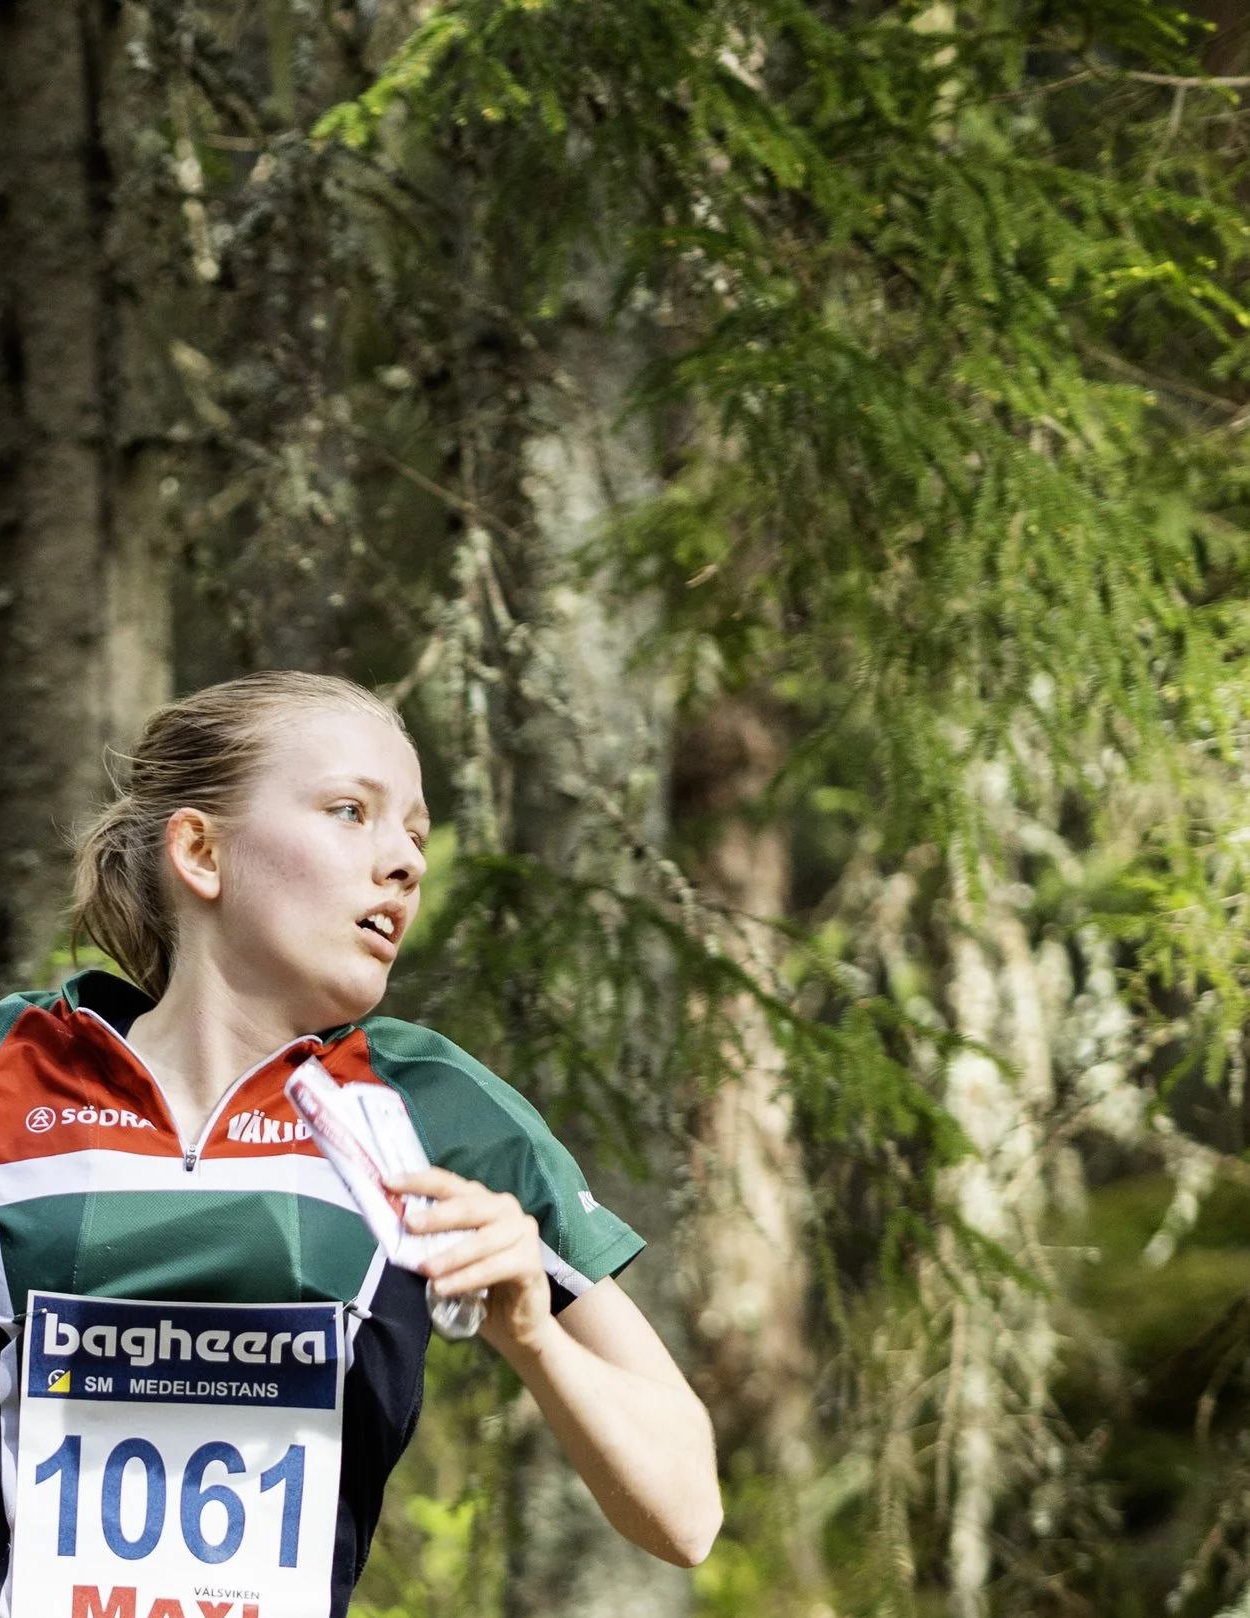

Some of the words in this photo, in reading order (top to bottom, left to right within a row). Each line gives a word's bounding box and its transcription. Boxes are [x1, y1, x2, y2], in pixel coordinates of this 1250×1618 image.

[61, 1105, 158, 1131] SÖDRA
[43, 1312, 326, 1367] bagheera
[84, 1376, 113, 1393] SM
[129, 1379, 279, 1398] MEDELDISTANS
[35, 1434, 306, 1569] 1061
[193, 1585, 260, 1600] VÄLSVIKEN
